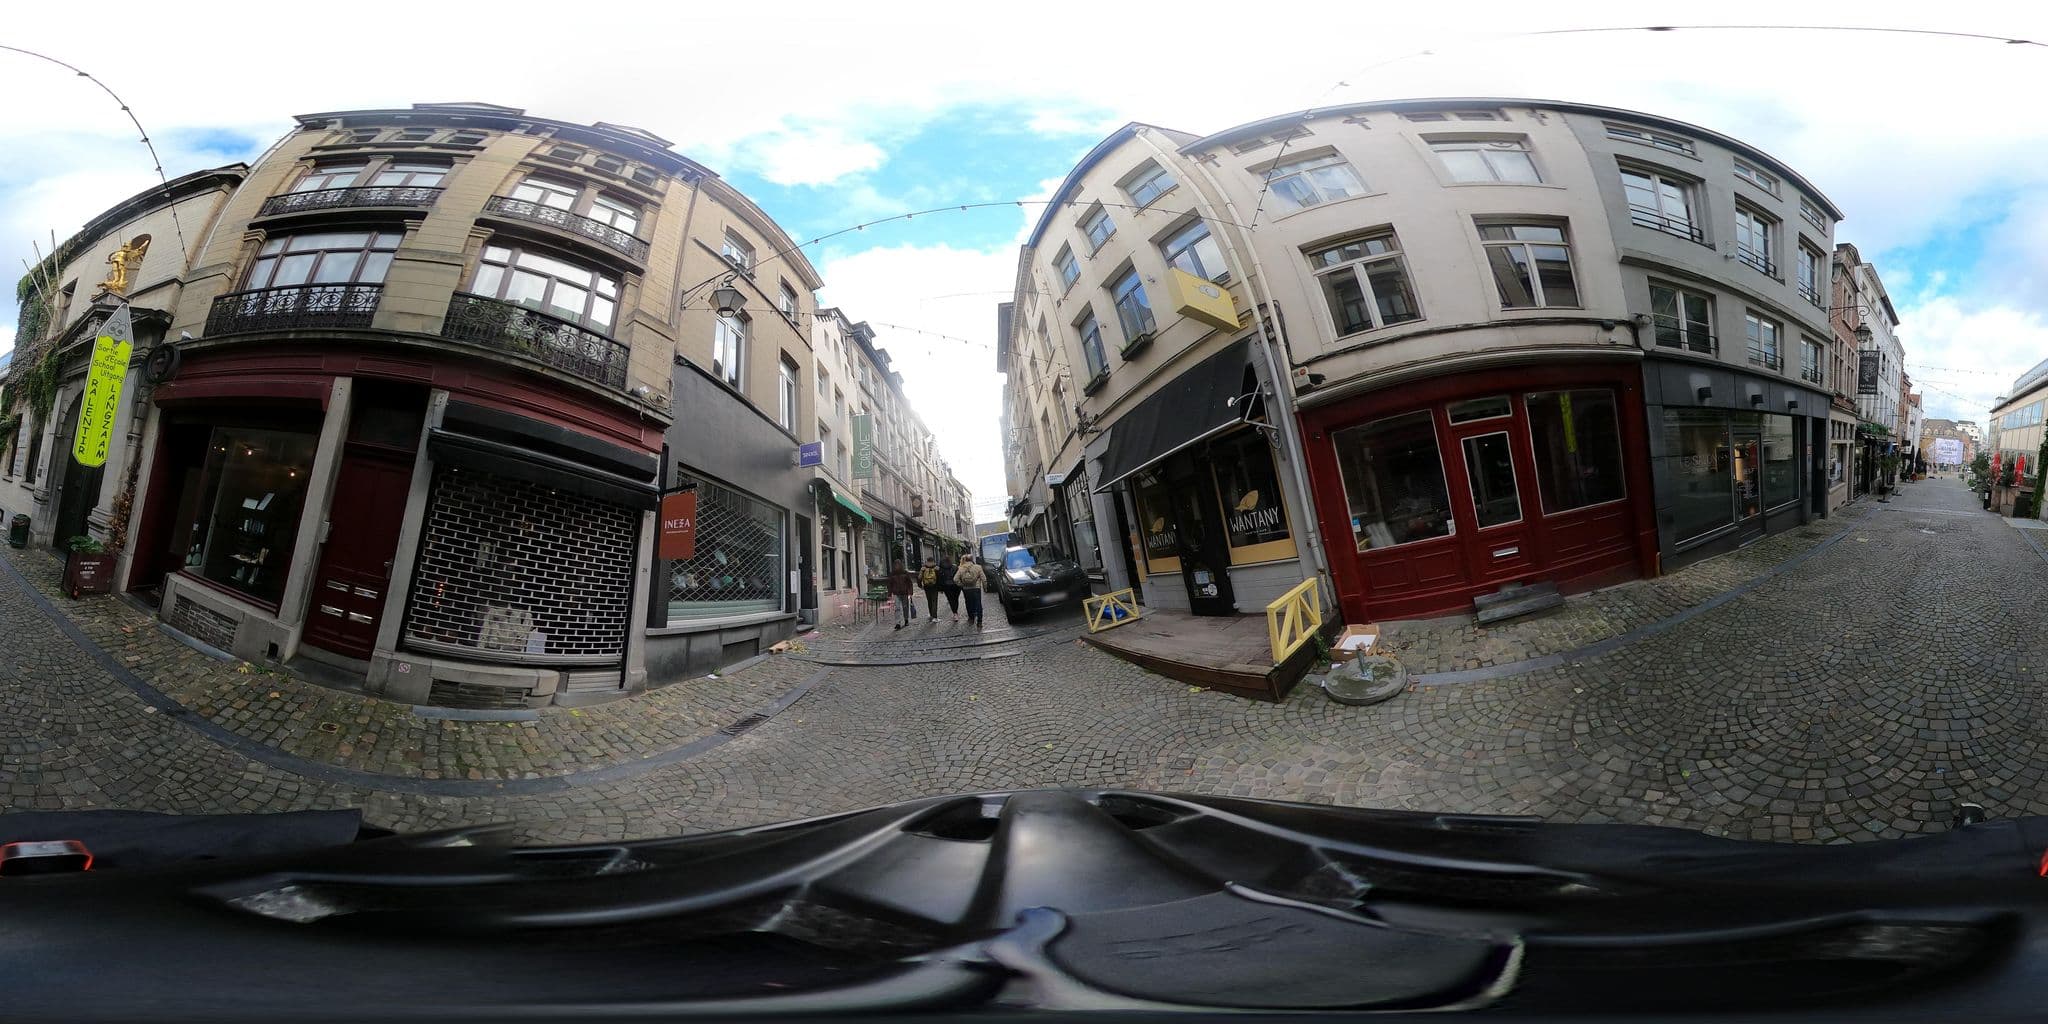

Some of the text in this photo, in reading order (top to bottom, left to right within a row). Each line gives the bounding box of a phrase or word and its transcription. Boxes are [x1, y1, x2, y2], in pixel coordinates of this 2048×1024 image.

[97, 344, 119, 355] Sortie
[93, 360, 116, 371] School
[78, 379, 98, 455] RALENTIR
[96, 384, 116, 459] LANGZAAM
[1229, 506, 1280, 533] WANTANY
